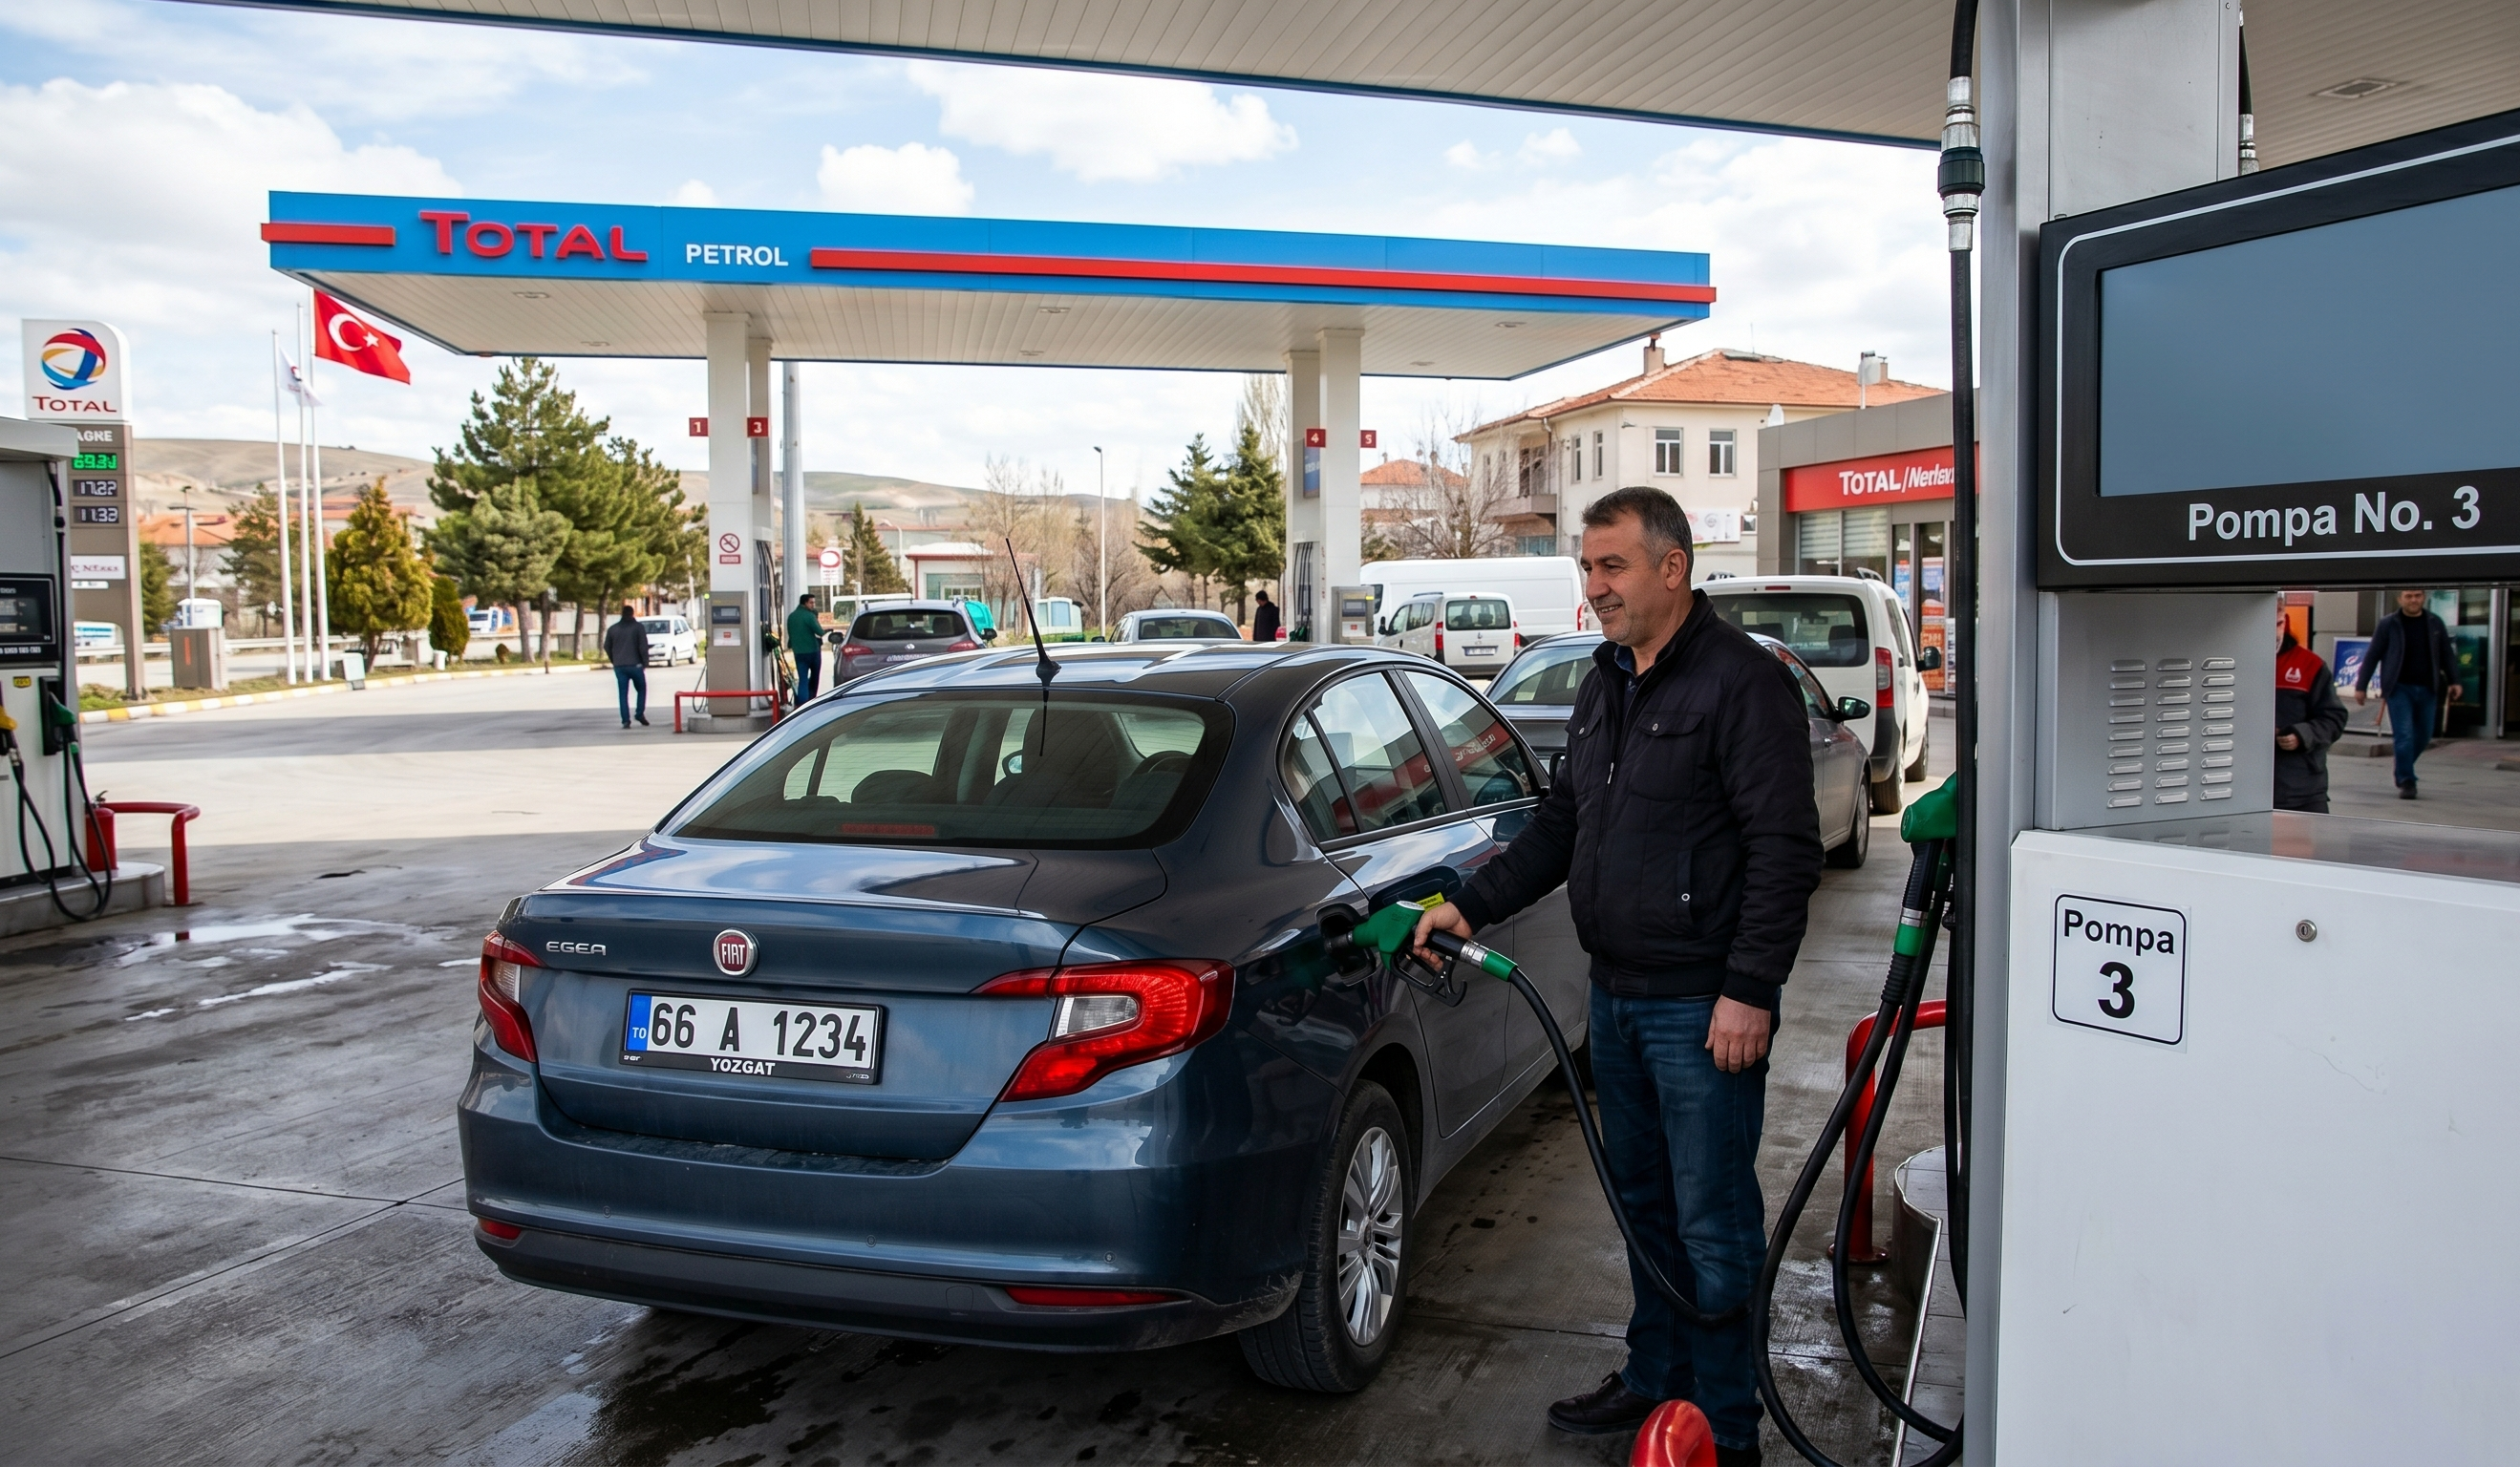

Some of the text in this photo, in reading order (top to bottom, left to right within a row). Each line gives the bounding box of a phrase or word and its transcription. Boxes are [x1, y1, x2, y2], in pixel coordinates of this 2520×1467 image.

[418, 209, 789, 267] TOTAL PETROL
[32, 395, 117, 413] TOTAL
[694, 421, 702, 434] 1
[753, 421, 763, 434] 3
[1311, 433, 1320, 444] 4
[1365, 434, 1373, 445] 5
[2189, 485, 2481, 547] Pompa No. 3
[2063, 908, 2175, 957] Pompa
[545, 941, 607, 956] EGEA
[721, 943, 746, 965] FIAT
[2097, 961, 2136, 1019] 3
[651, 1003, 866, 1062] 66 A 1234
[710, 1057, 776, 1075] YOZGAT
